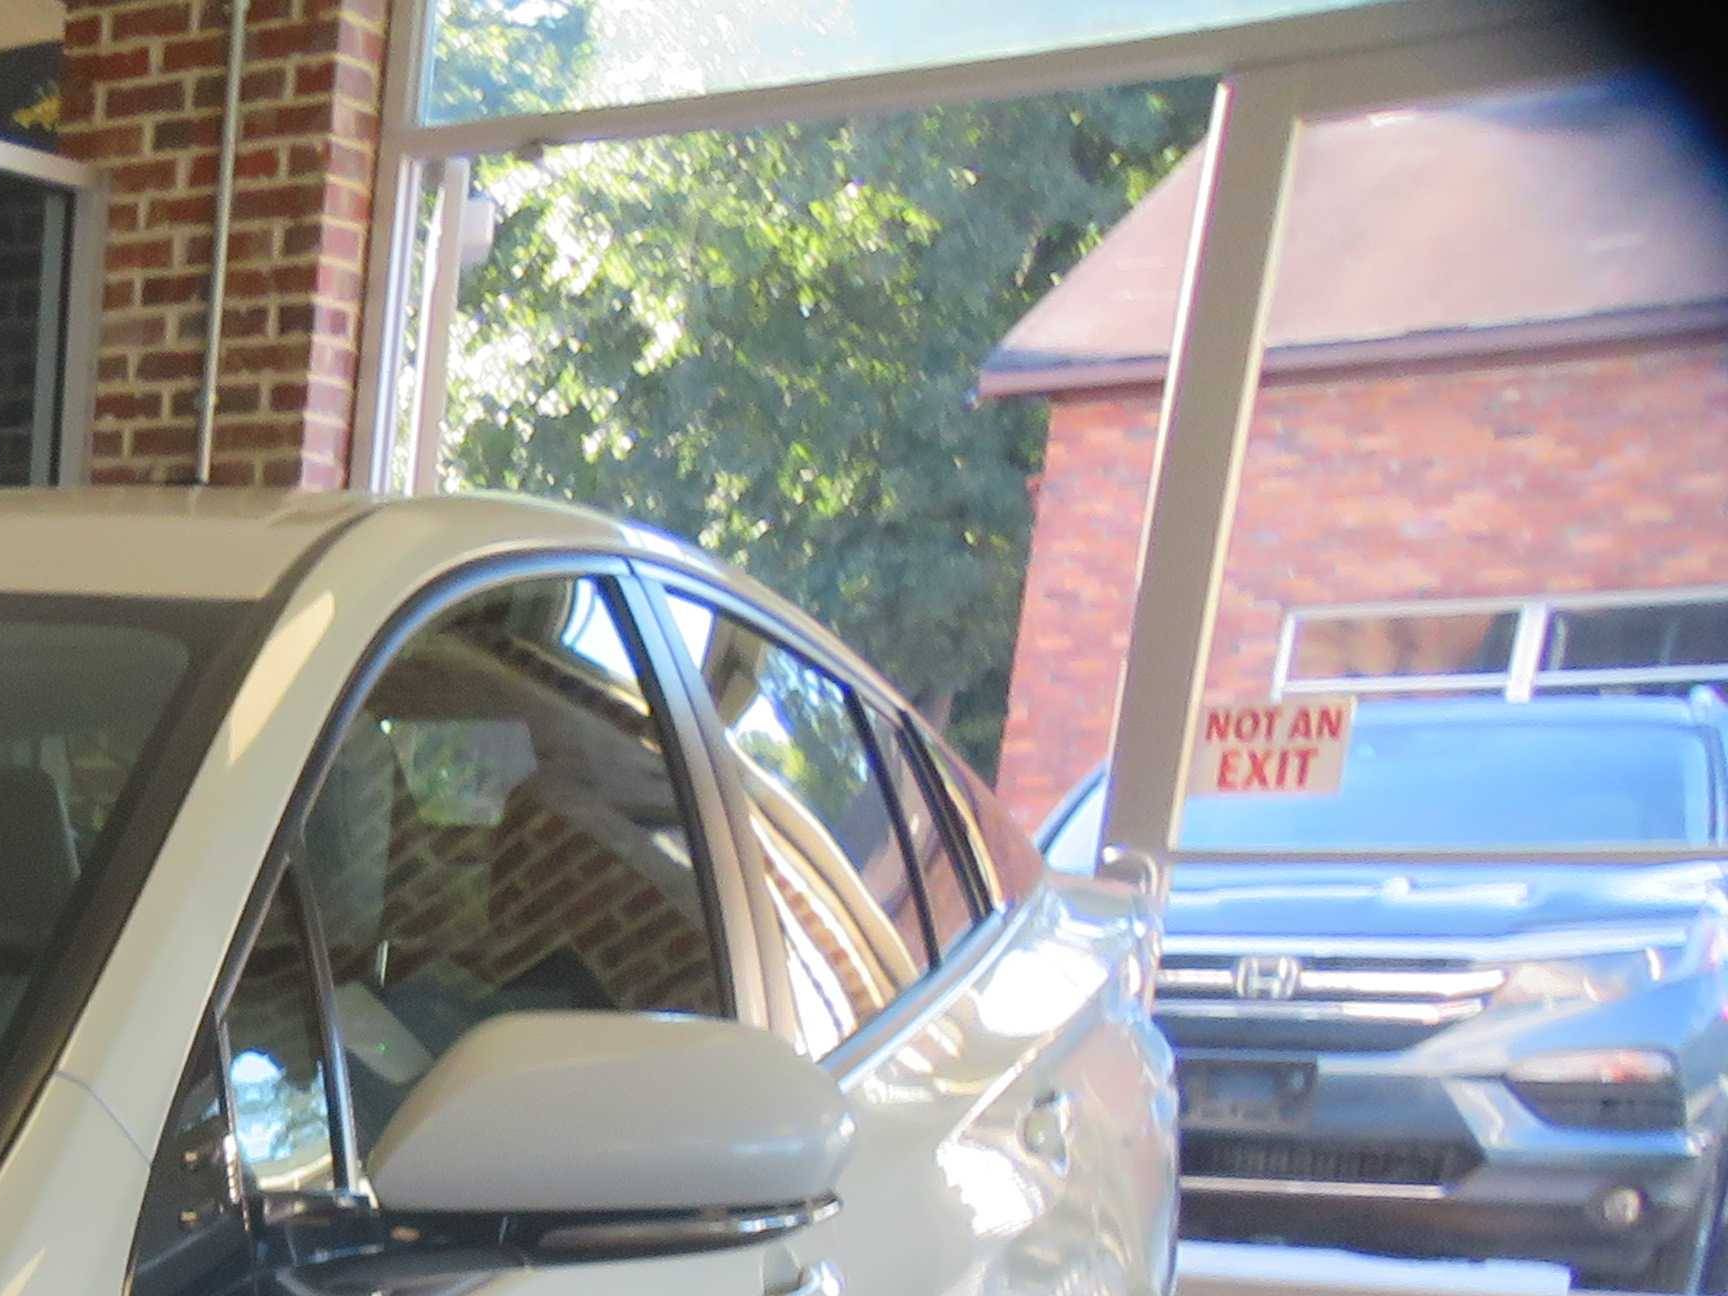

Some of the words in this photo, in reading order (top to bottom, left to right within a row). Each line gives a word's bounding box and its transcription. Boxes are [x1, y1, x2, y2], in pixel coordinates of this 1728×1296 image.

[1205, 704, 1282, 742] NOT
[1290, 704, 1343, 740] AN
[1216, 747, 1319, 791] EXIT
